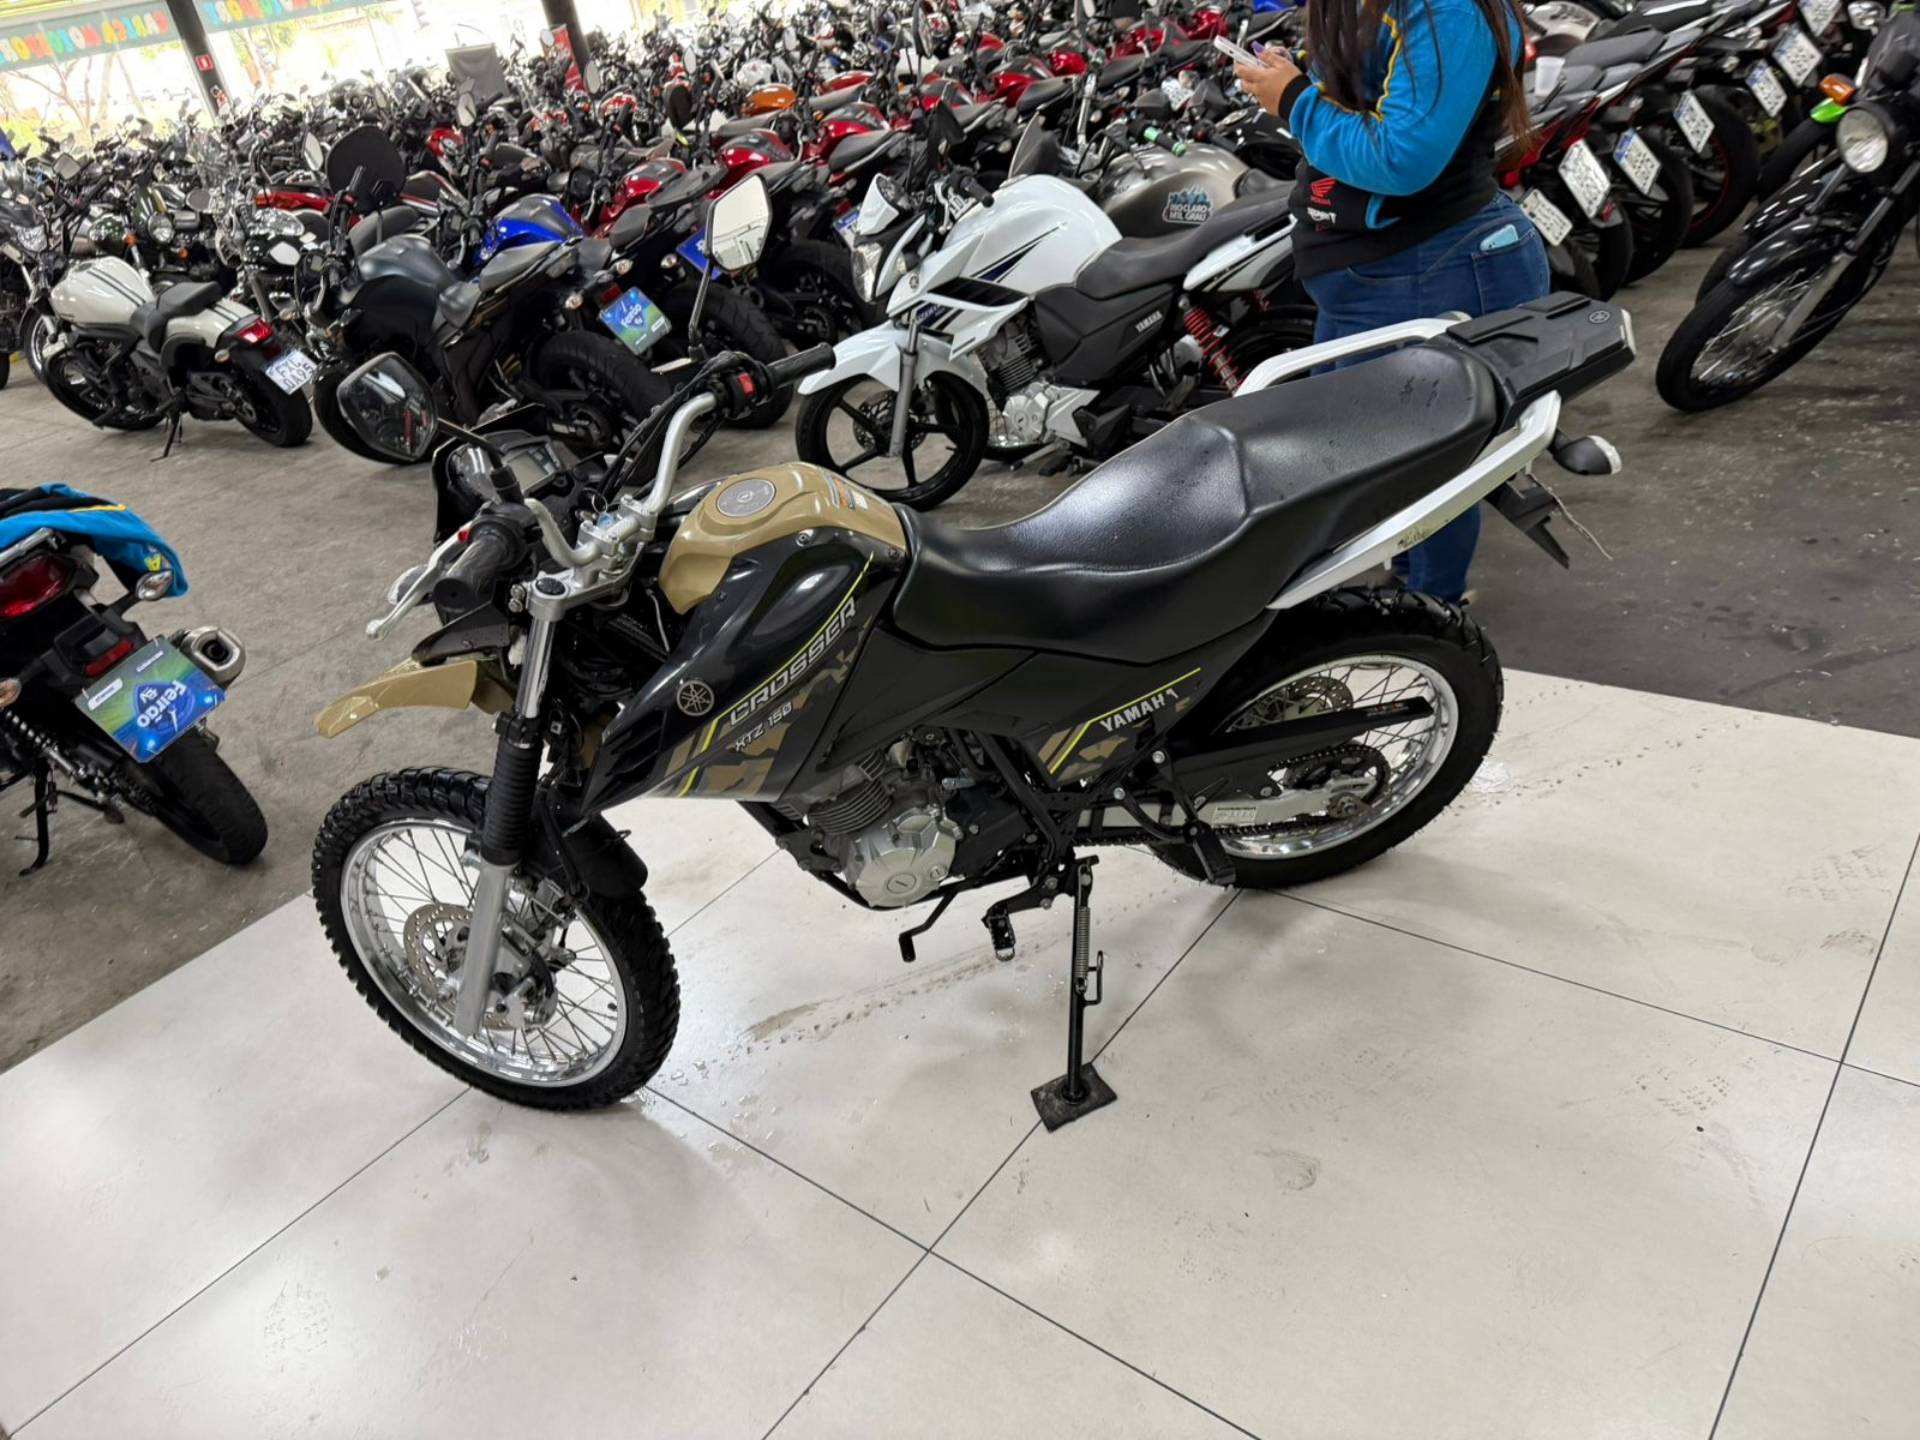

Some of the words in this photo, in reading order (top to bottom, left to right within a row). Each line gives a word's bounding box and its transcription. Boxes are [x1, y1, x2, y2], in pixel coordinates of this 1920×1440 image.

[730, 596, 856, 726] CROSSER
[137, 680, 187, 727] Feirão
[735, 722, 764, 752] XTZ
[767, 701, 792, 727] 150
